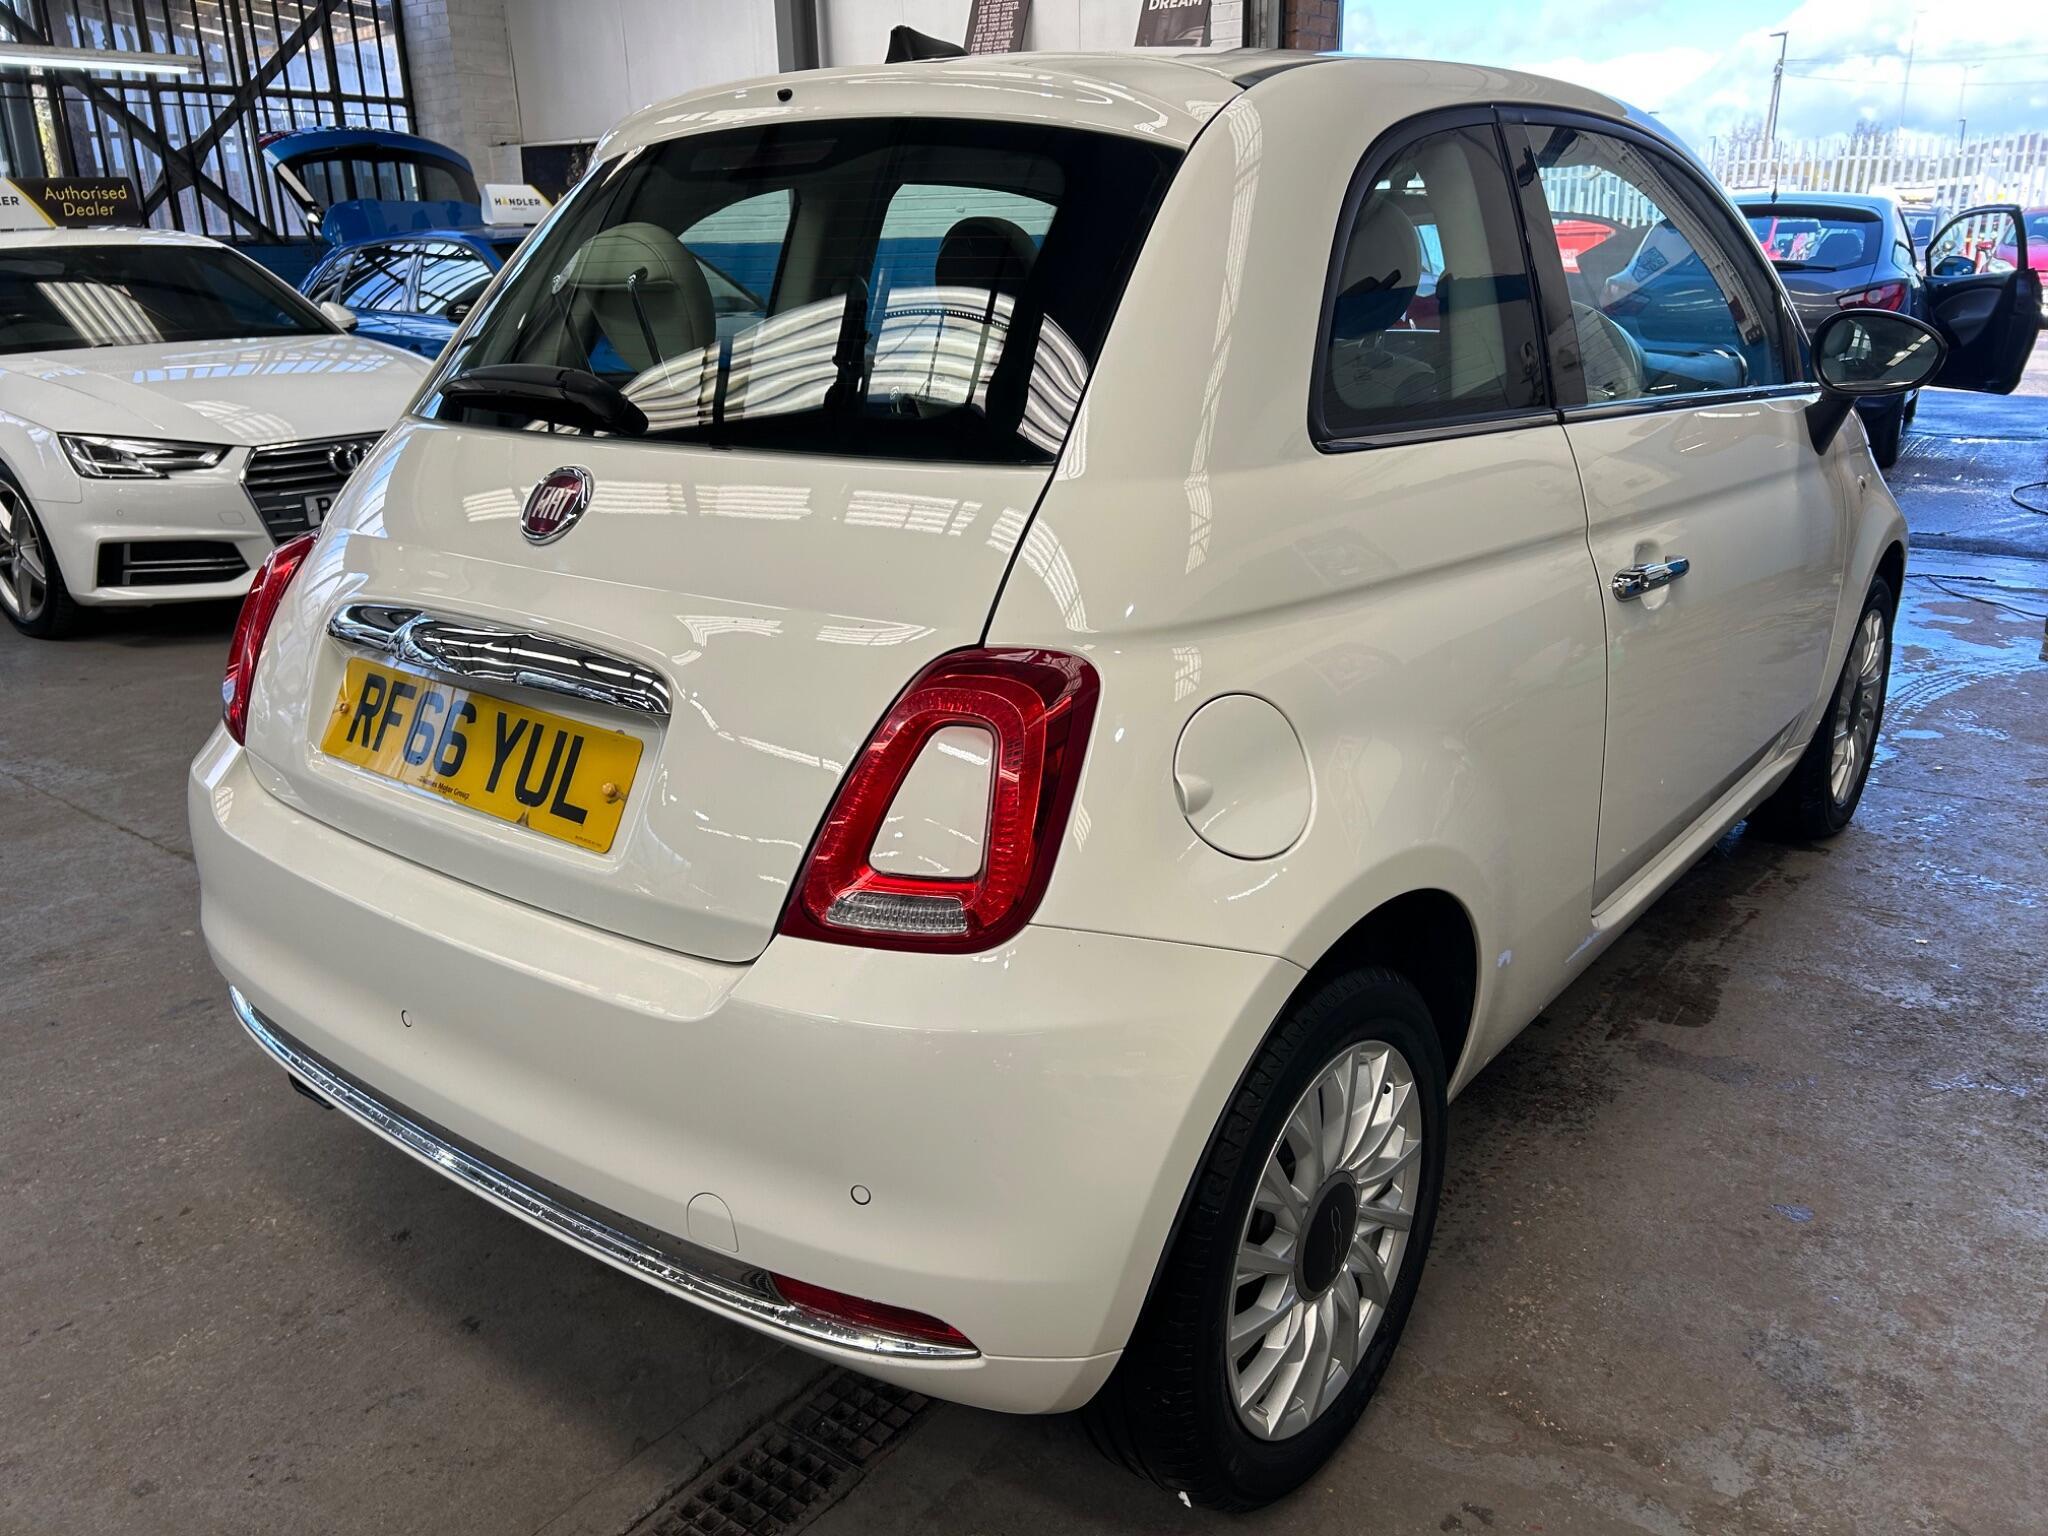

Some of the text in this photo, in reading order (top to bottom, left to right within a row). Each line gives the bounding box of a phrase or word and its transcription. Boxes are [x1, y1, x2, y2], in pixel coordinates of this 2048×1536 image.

[1148, 0, 1203, 10] DREAM
[45, 185, 128, 200] Authorised
[0, 196, 20, 206] ER
[62, 201, 115, 217] Dealer
[531, 486, 576, 521] FIAT
[346, 672, 588, 825] RF66 YUL
